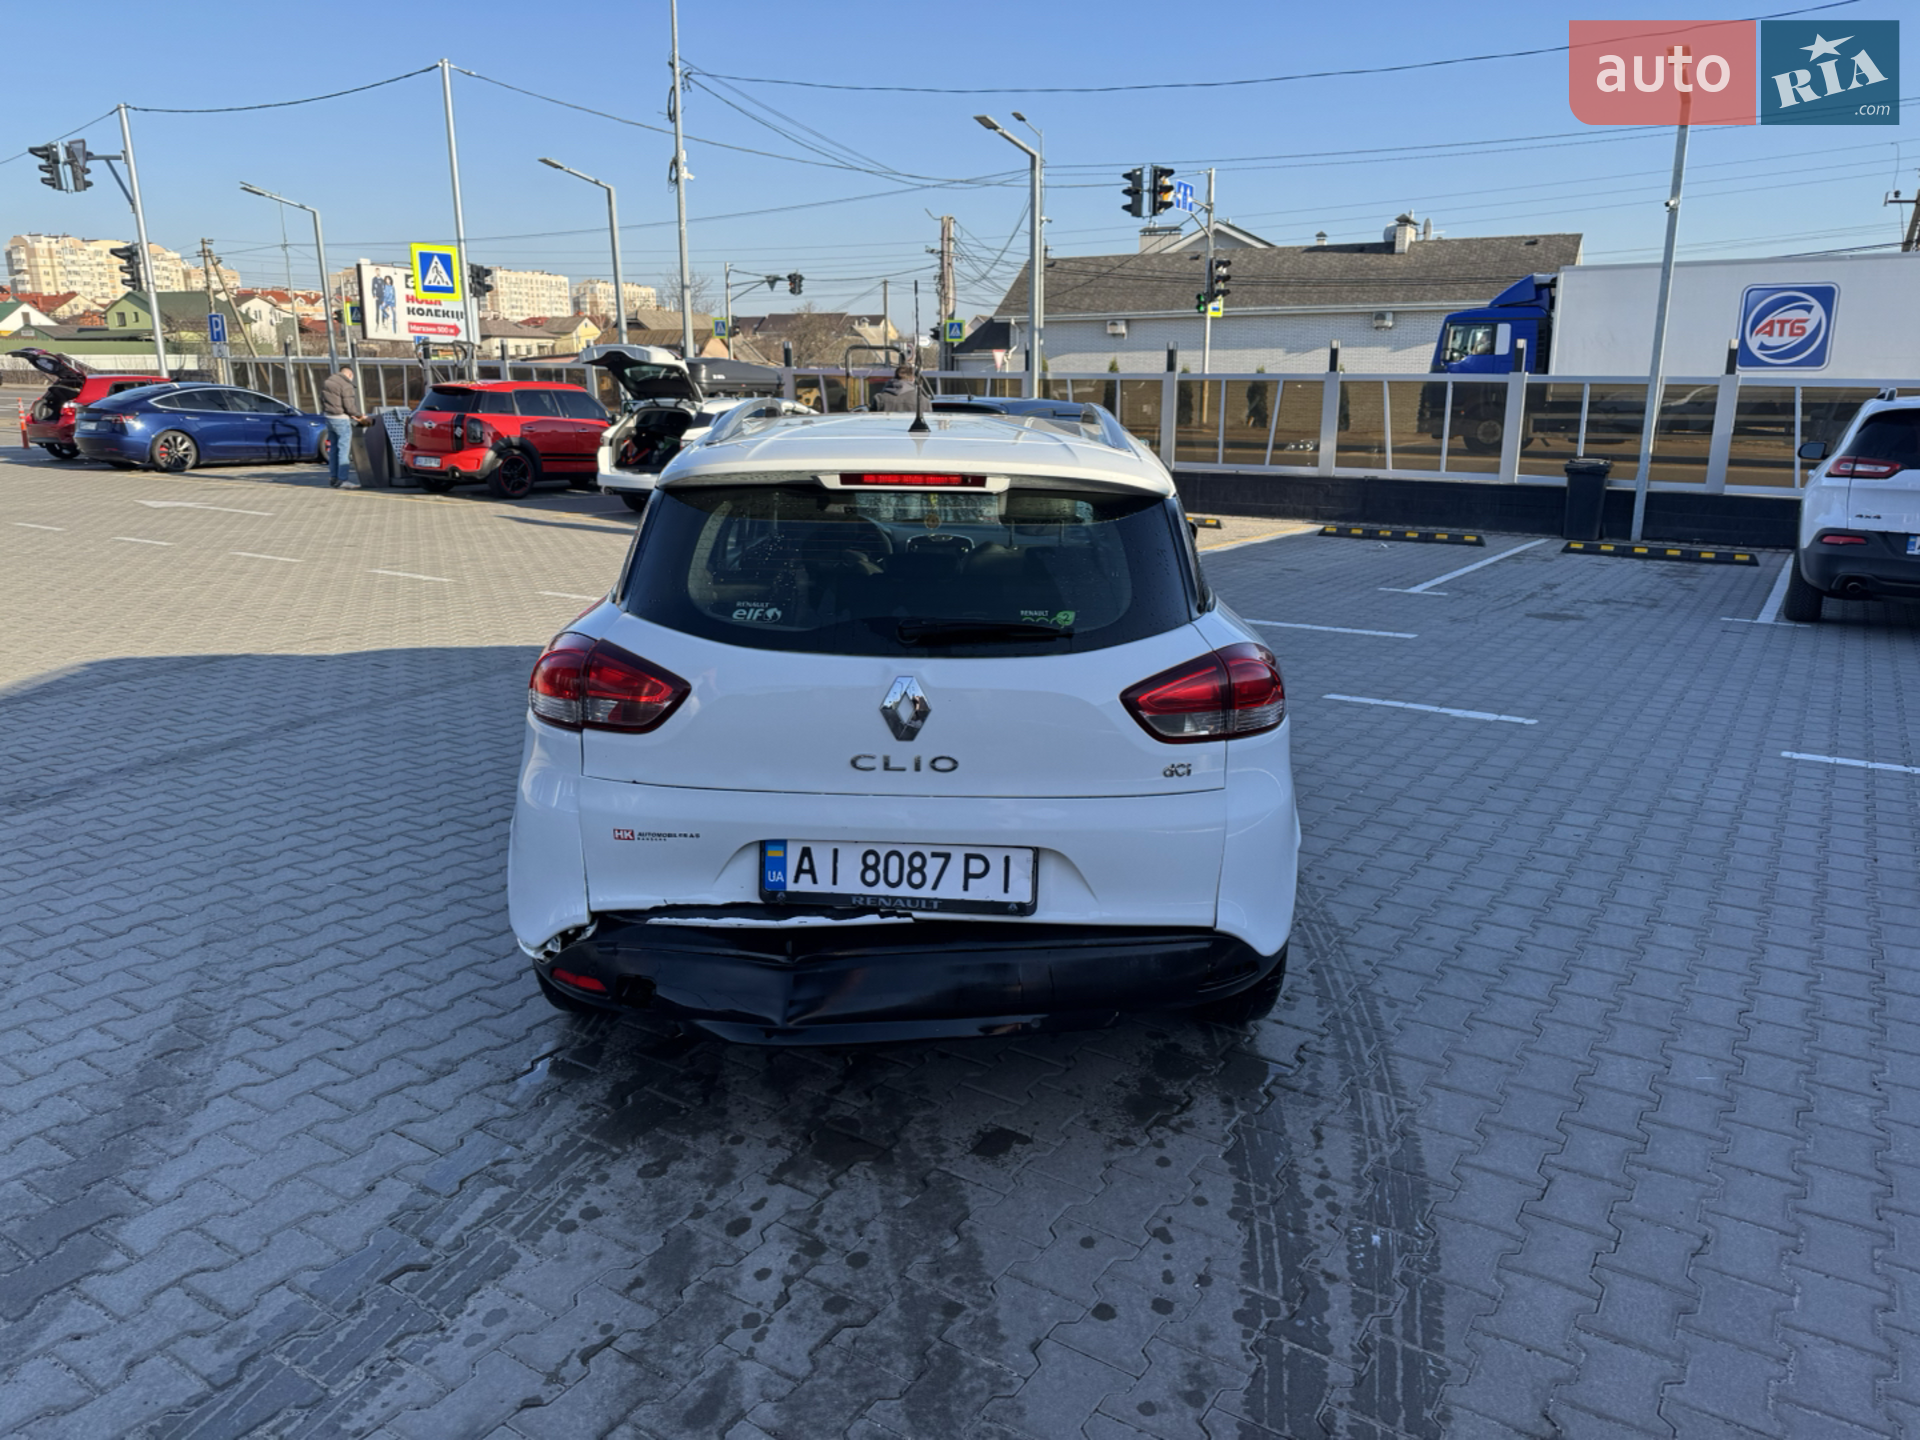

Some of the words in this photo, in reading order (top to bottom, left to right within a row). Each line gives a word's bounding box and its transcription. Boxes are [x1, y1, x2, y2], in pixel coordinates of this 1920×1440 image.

[406, 306, 464, 321] КОЛЕКЦІ
[211, 317, 222, 339] P
[1754, 317, 1811, 337] АТБ
[732, 608, 764, 620] elf
[850, 754, 959, 773] CLIO
[615, 829, 634, 840] HK
[767, 871, 784, 882] UA
[793, 846, 839, 885] AI
[860, 849, 951, 891] 8087
[962, 853, 1011, 894] PI
[851, 896, 942, 910] RENAULT
